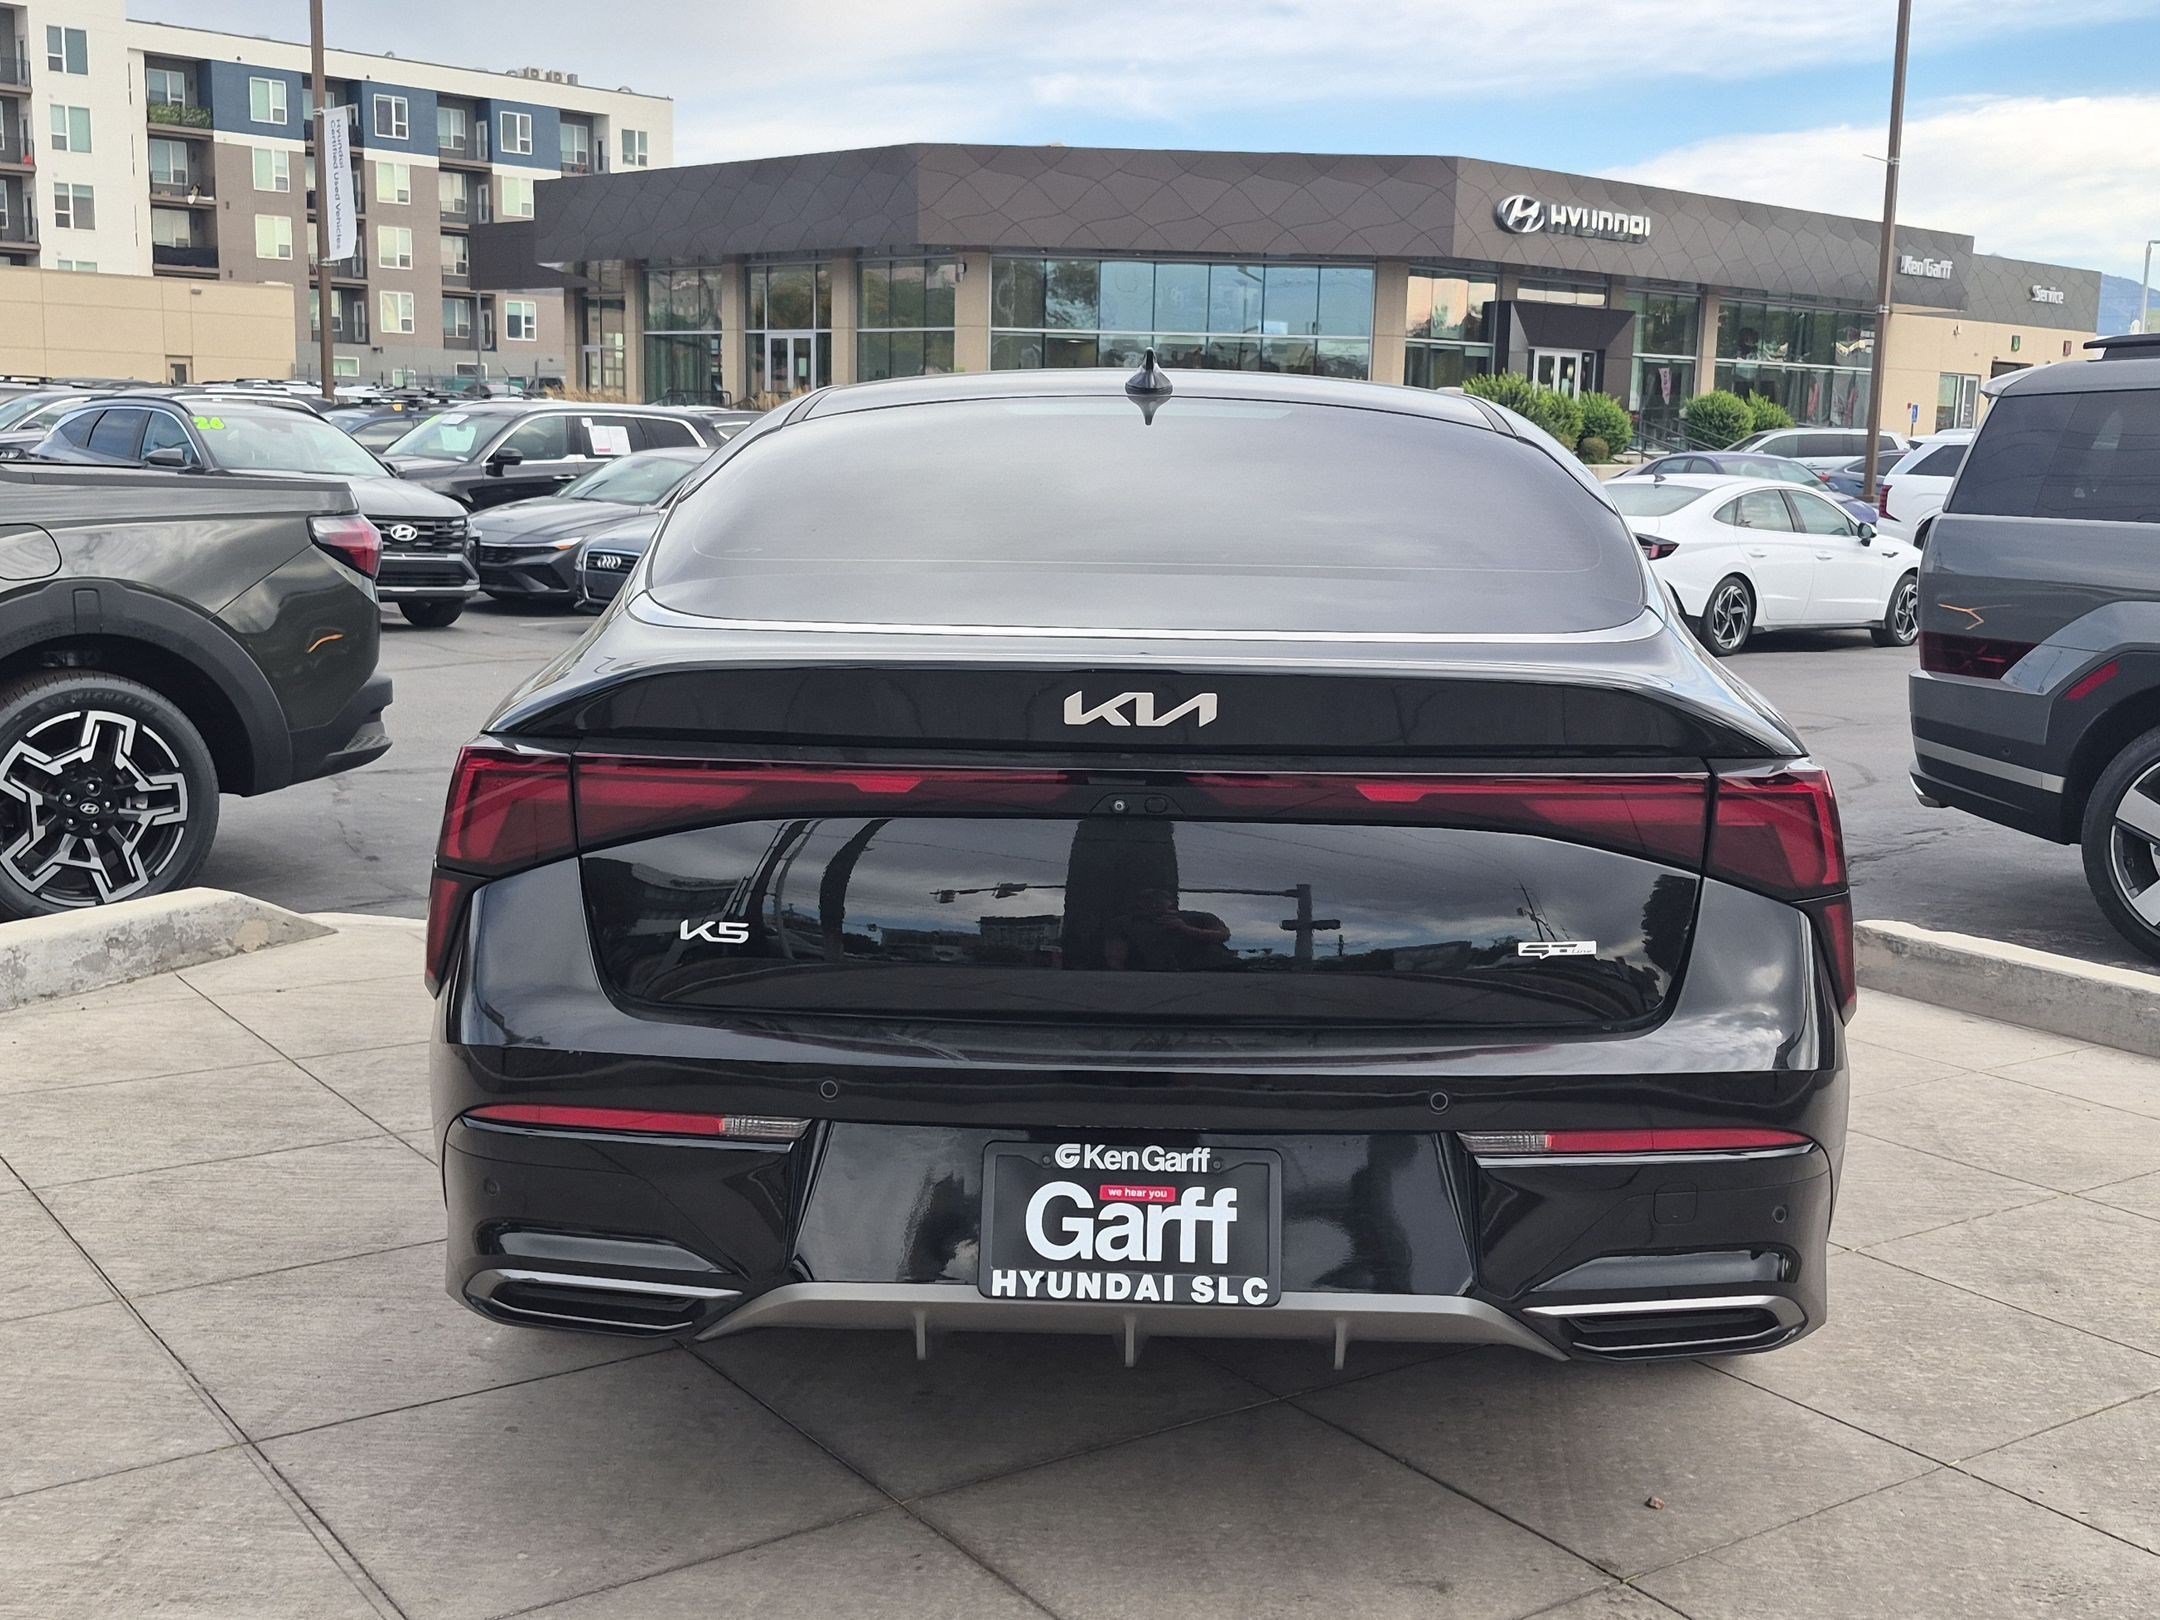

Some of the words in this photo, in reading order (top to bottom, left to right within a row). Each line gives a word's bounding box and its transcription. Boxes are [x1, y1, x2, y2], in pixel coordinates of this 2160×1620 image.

[330, 119, 338, 170] Certified
[336, 119, 344, 169] Hyundai
[333, 172, 341, 200] Used
[1923, 258, 1953, 280] Garff
[2031, 284, 2064, 304] Service
[1063, 690, 1218, 727] KIA
[679, 919, 750, 944] K5
[1107, 1189, 1124, 1198] we
[1124, 1187, 1147, 1199] hear
[1148, 1189, 1168, 1201] you
[1025, 1181, 1237, 1264] Garff
[991, 1270, 1173, 1302] HYUNDAI
[1190, 1275, 1269, 1306] SLC
